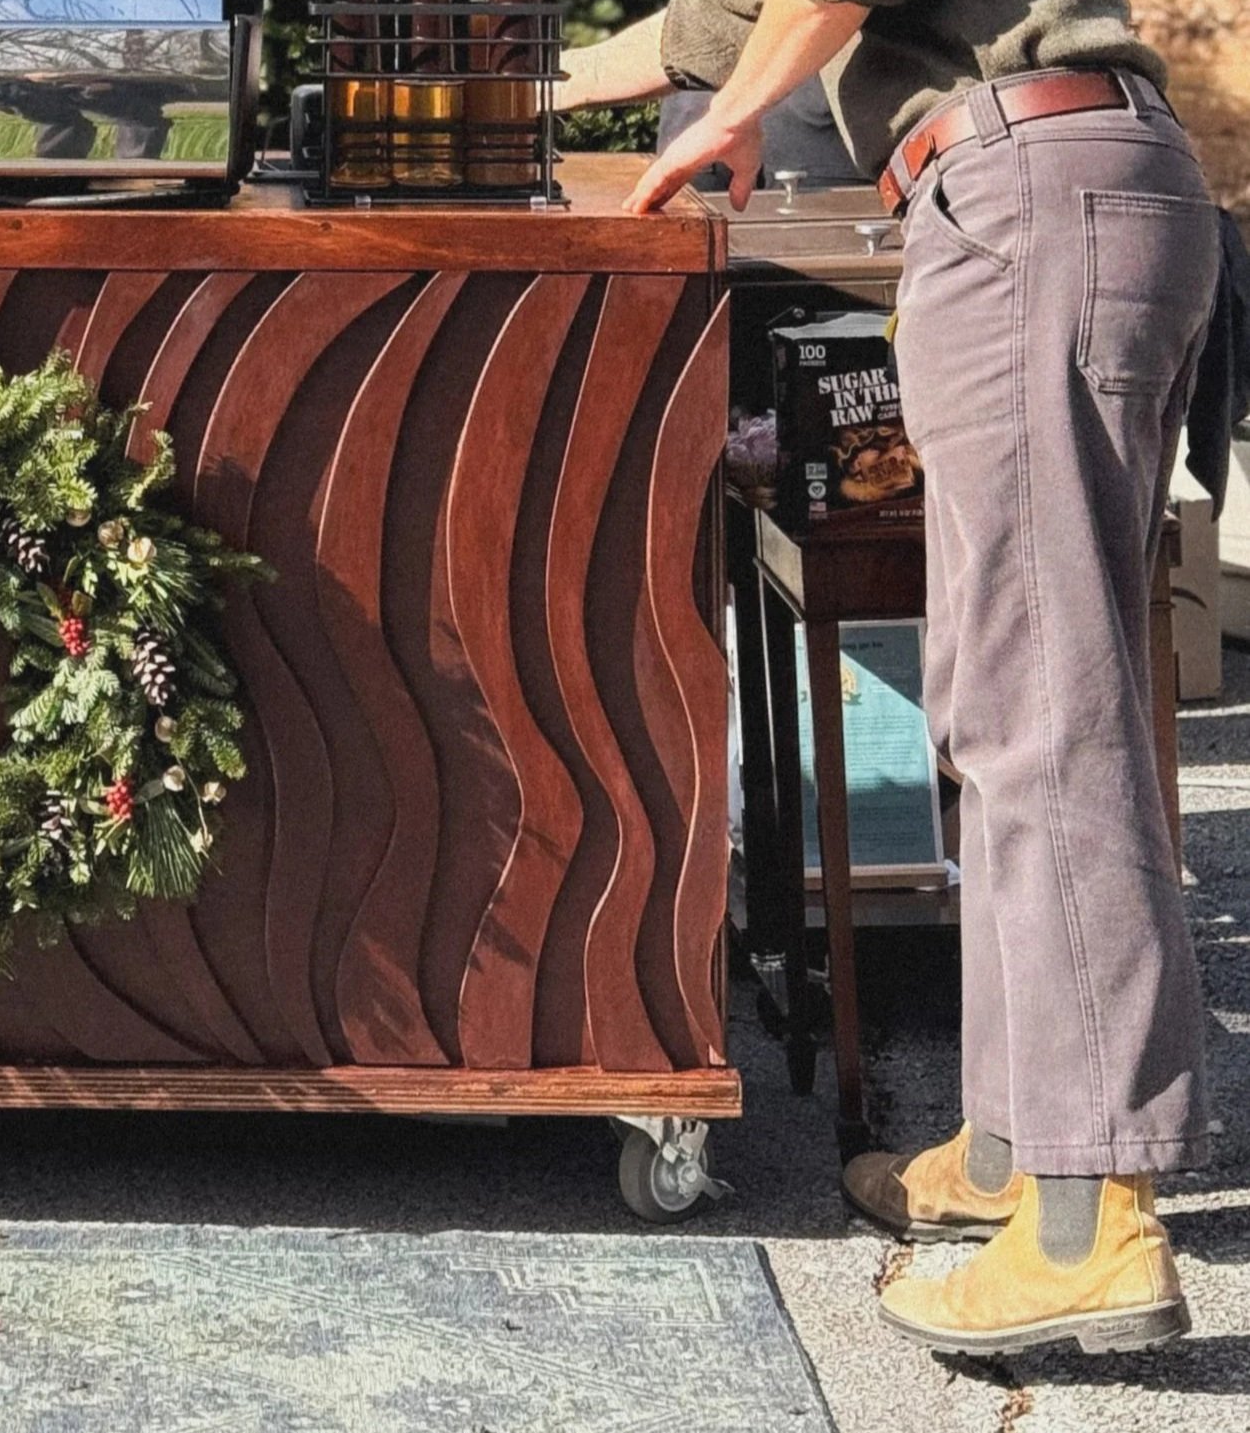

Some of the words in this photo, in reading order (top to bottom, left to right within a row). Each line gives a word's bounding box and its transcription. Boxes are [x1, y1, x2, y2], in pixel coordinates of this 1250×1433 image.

[798, 344, 826, 360] 100
[817, 368, 887, 395] SUGAR
[833, 389, 856, 409] IN
[830, 405, 874, 427] RAW
